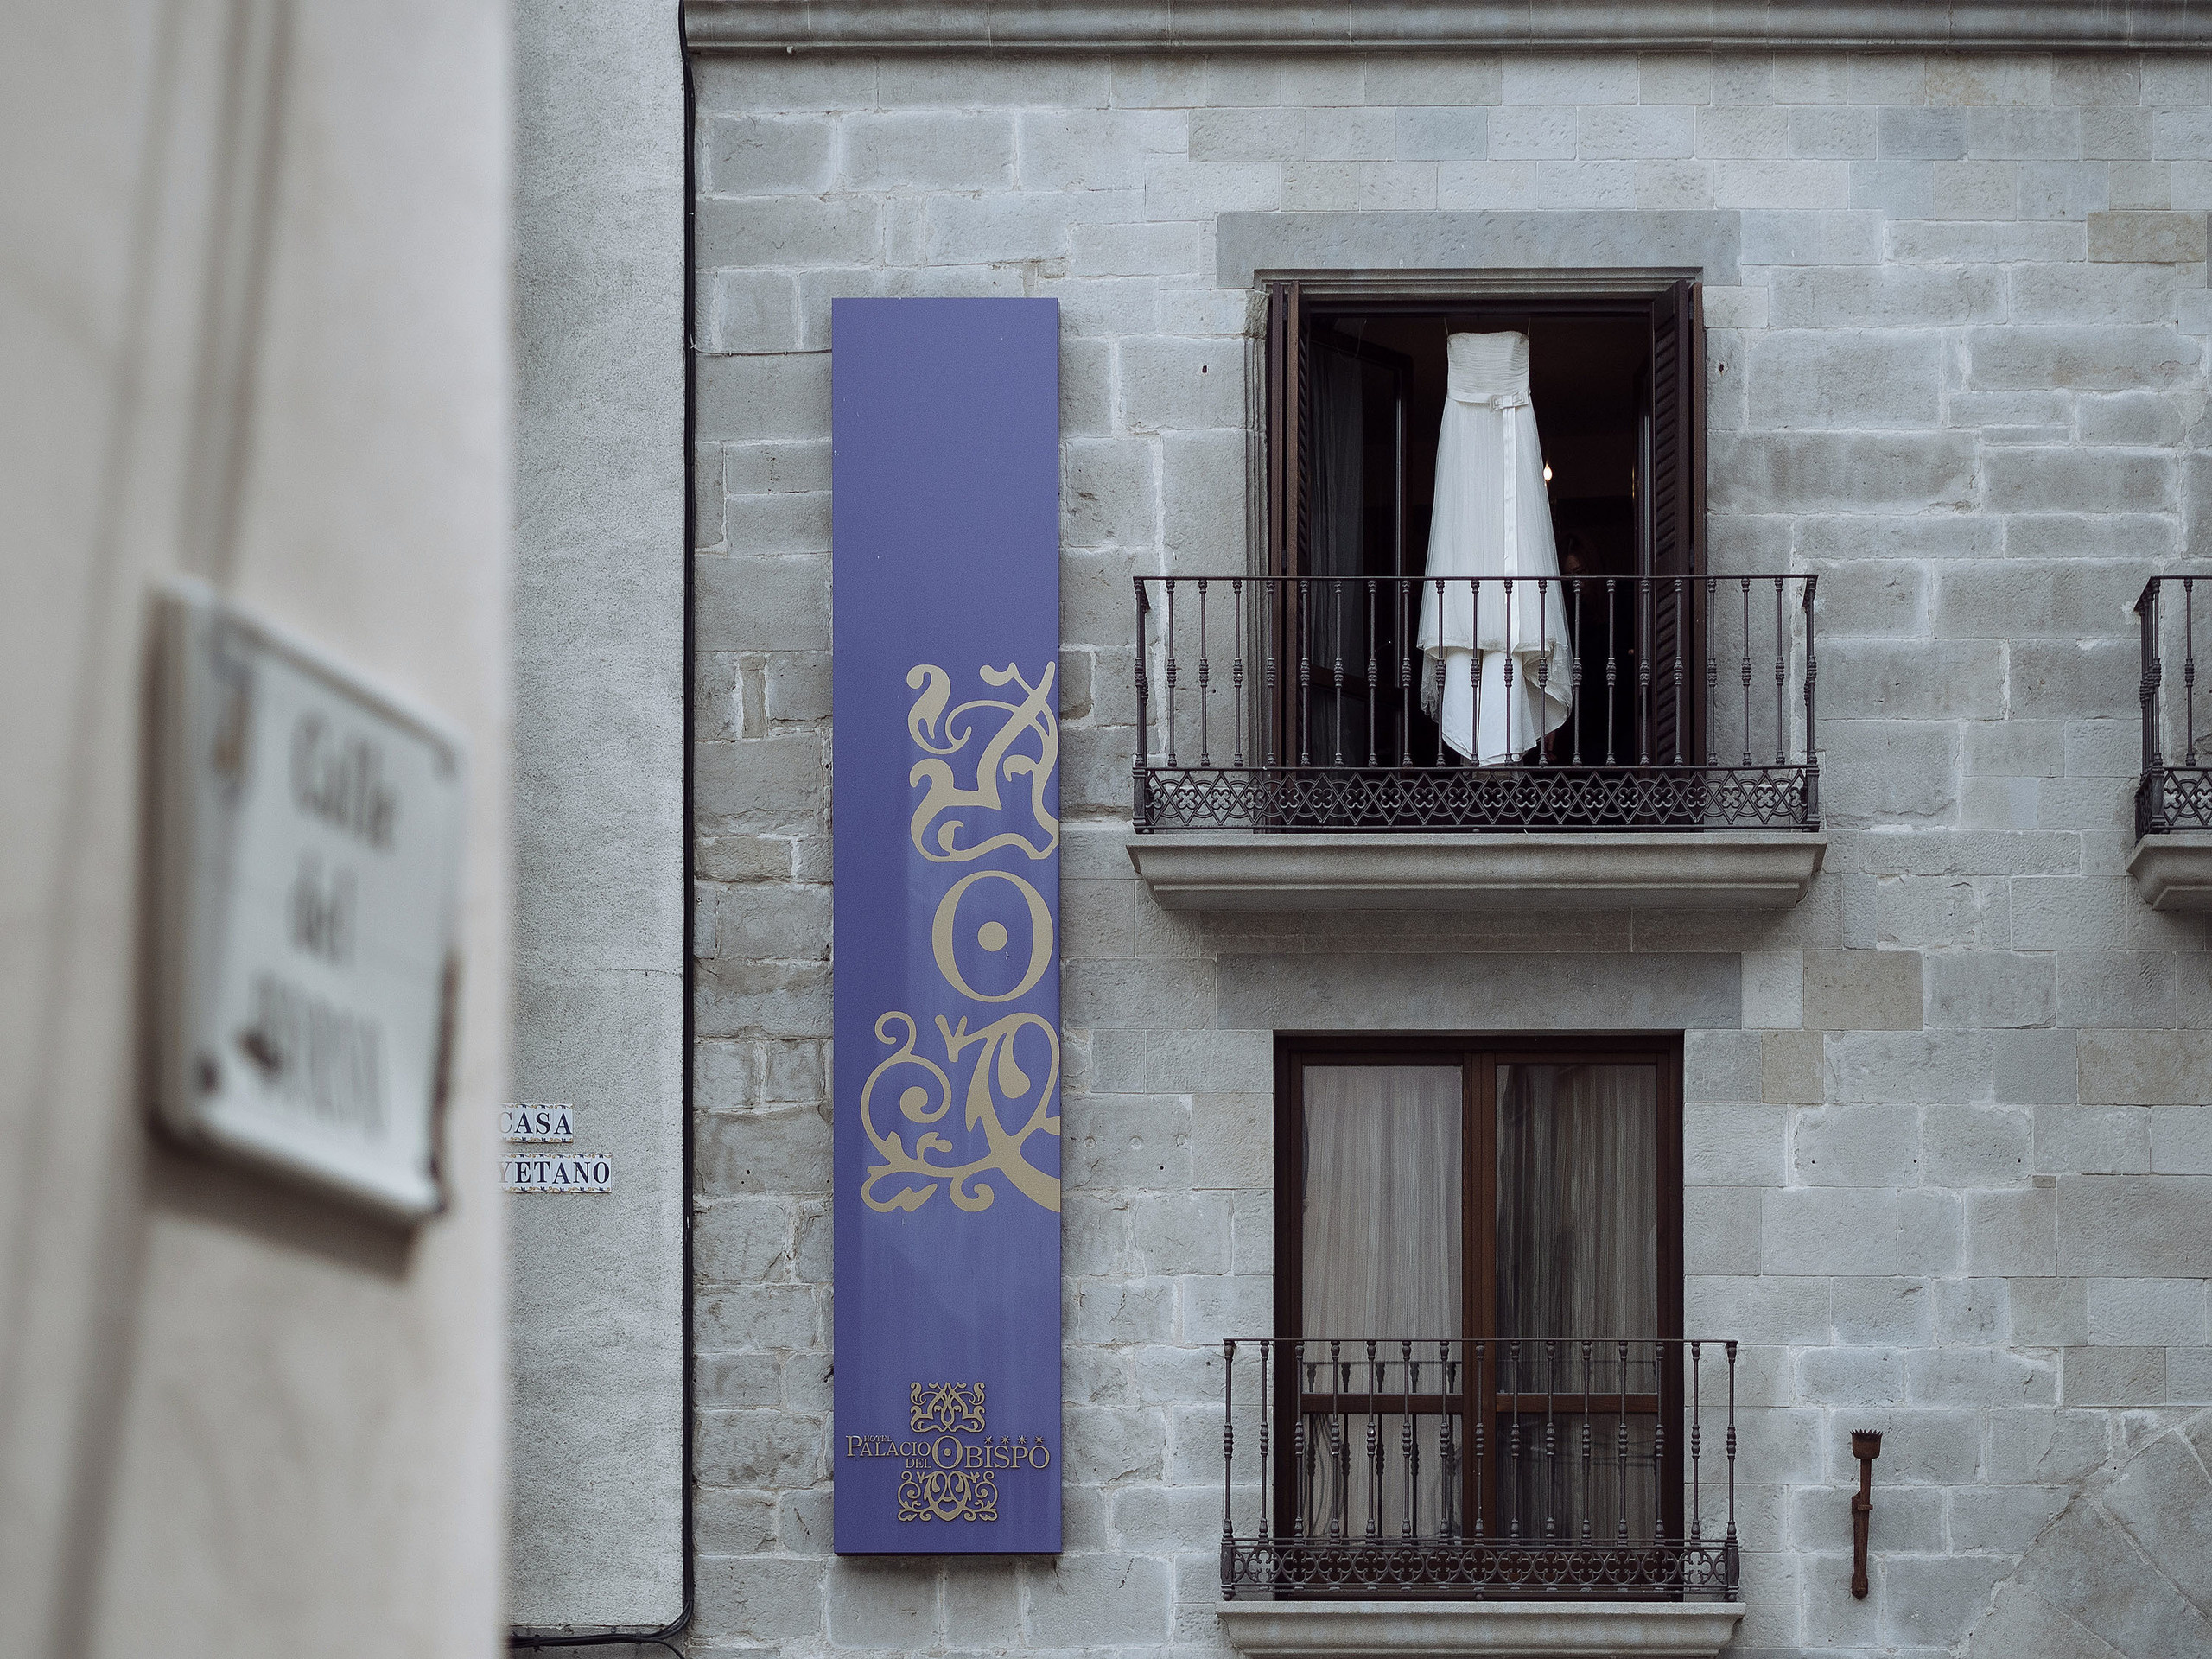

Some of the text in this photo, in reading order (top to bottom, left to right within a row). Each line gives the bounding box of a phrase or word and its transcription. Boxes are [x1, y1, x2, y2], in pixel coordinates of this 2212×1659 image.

[498, 1111, 572, 1135] CASA
[498, 1161, 610, 1184] YETANO
[846, 1435, 931, 1457] PALACIO
[931, 1435, 1050, 1469] OBISPO
[906, 1458, 932, 1469] DEL
